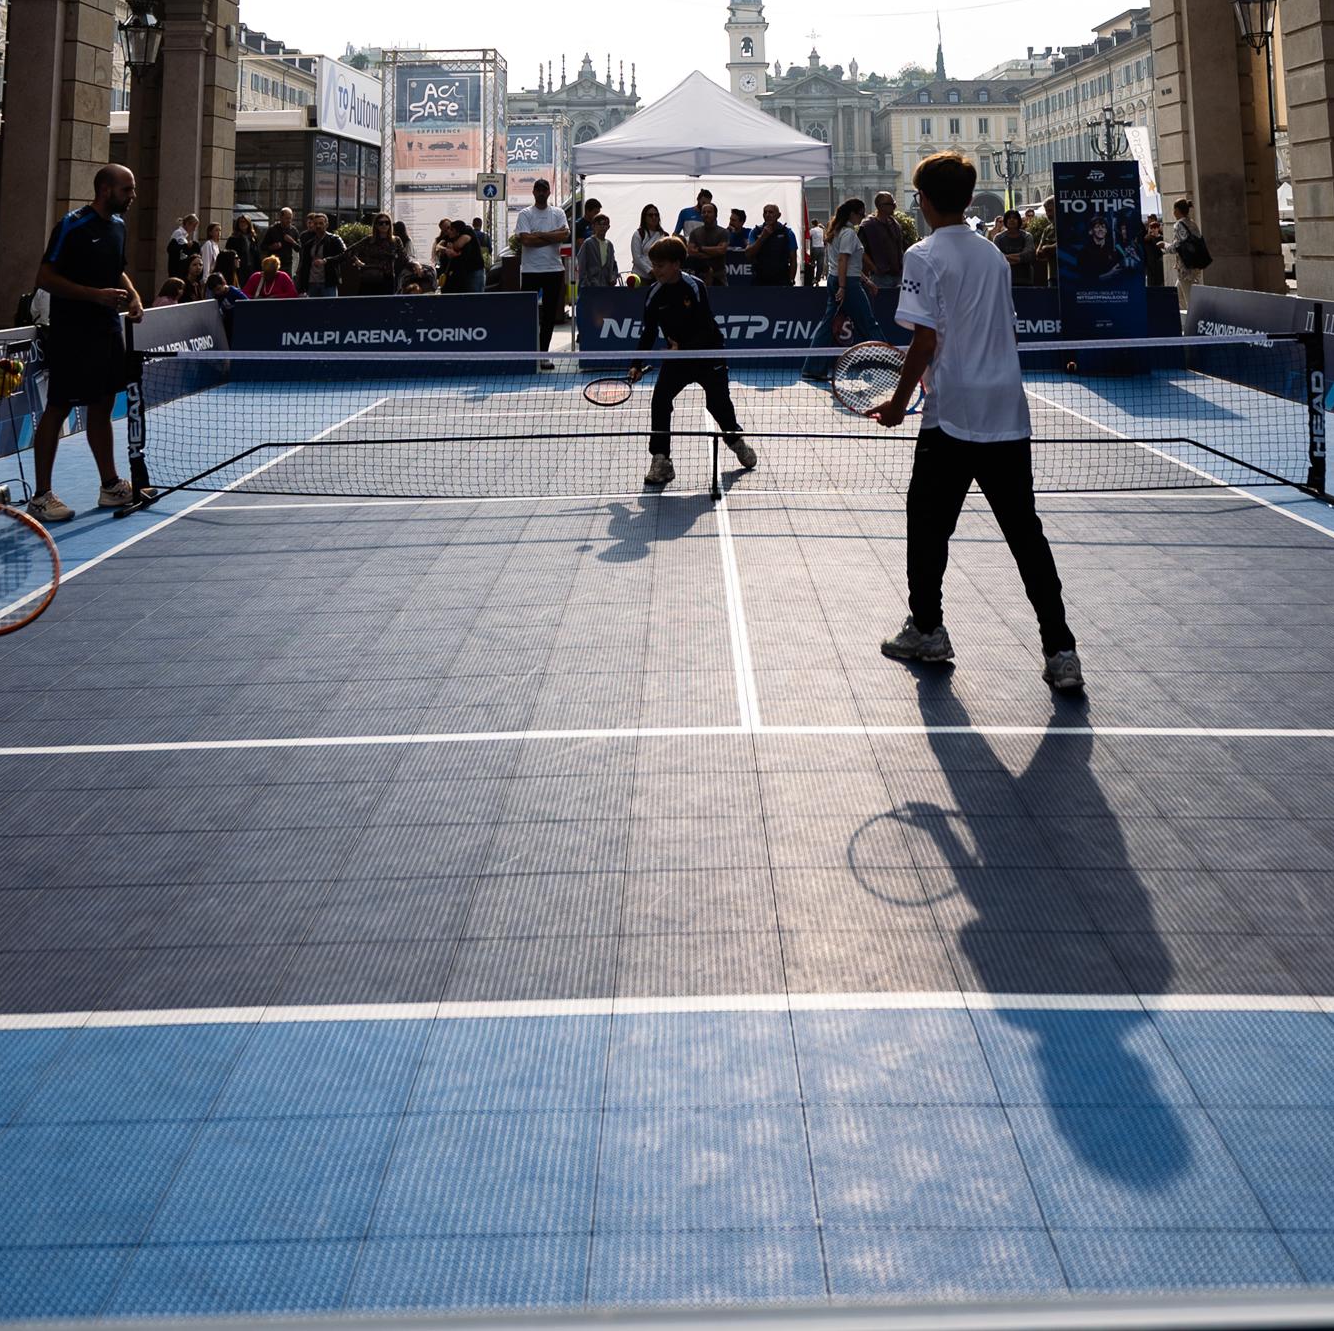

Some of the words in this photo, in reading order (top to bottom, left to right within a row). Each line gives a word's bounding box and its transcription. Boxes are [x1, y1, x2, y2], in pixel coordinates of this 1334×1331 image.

[1059, 189, 1069, 199] IT
[1070, 189, 1090, 199] ALL
[1091, 188, 1120, 199] ADDS
[1120, 188, 1136, 198] UP
[1059, 199, 1088, 214] TO
[1090, 198, 1136, 213] THIS
[189, 334, 214, 352] TORINO
[281, 329, 341, 347] INALPI
[343, 328, 413, 347] ARENA,
[415, 326, 488, 344] TORINO
[126, 381, 143, 459] HEAD
[1311, 370, 1326, 458] HEAD
